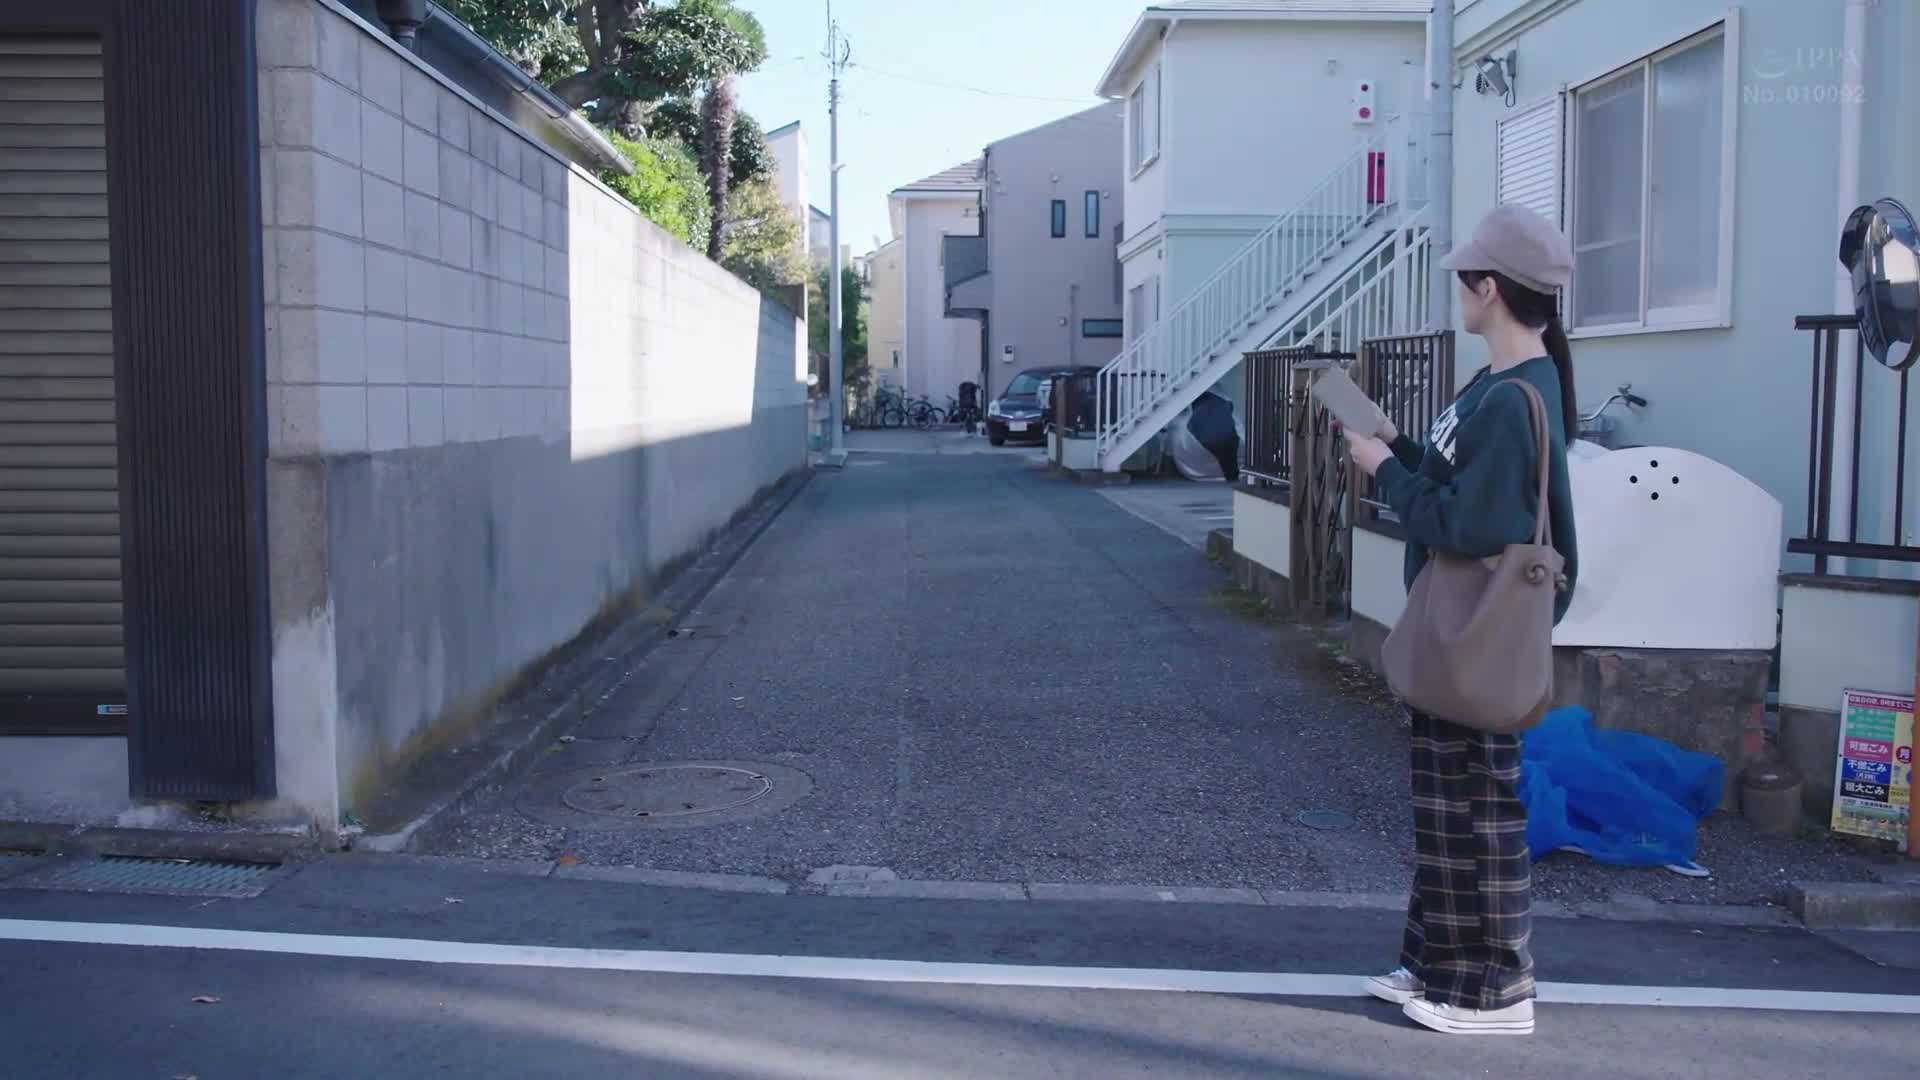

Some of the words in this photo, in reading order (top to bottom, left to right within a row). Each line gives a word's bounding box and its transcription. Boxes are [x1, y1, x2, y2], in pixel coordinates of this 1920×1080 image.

[1848, 740, 1888, 754] 可燃ごみ
[1847, 759, 1887, 773] 不燃ごみ
[1845, 782, 1885, 796] 粗大ごみ
